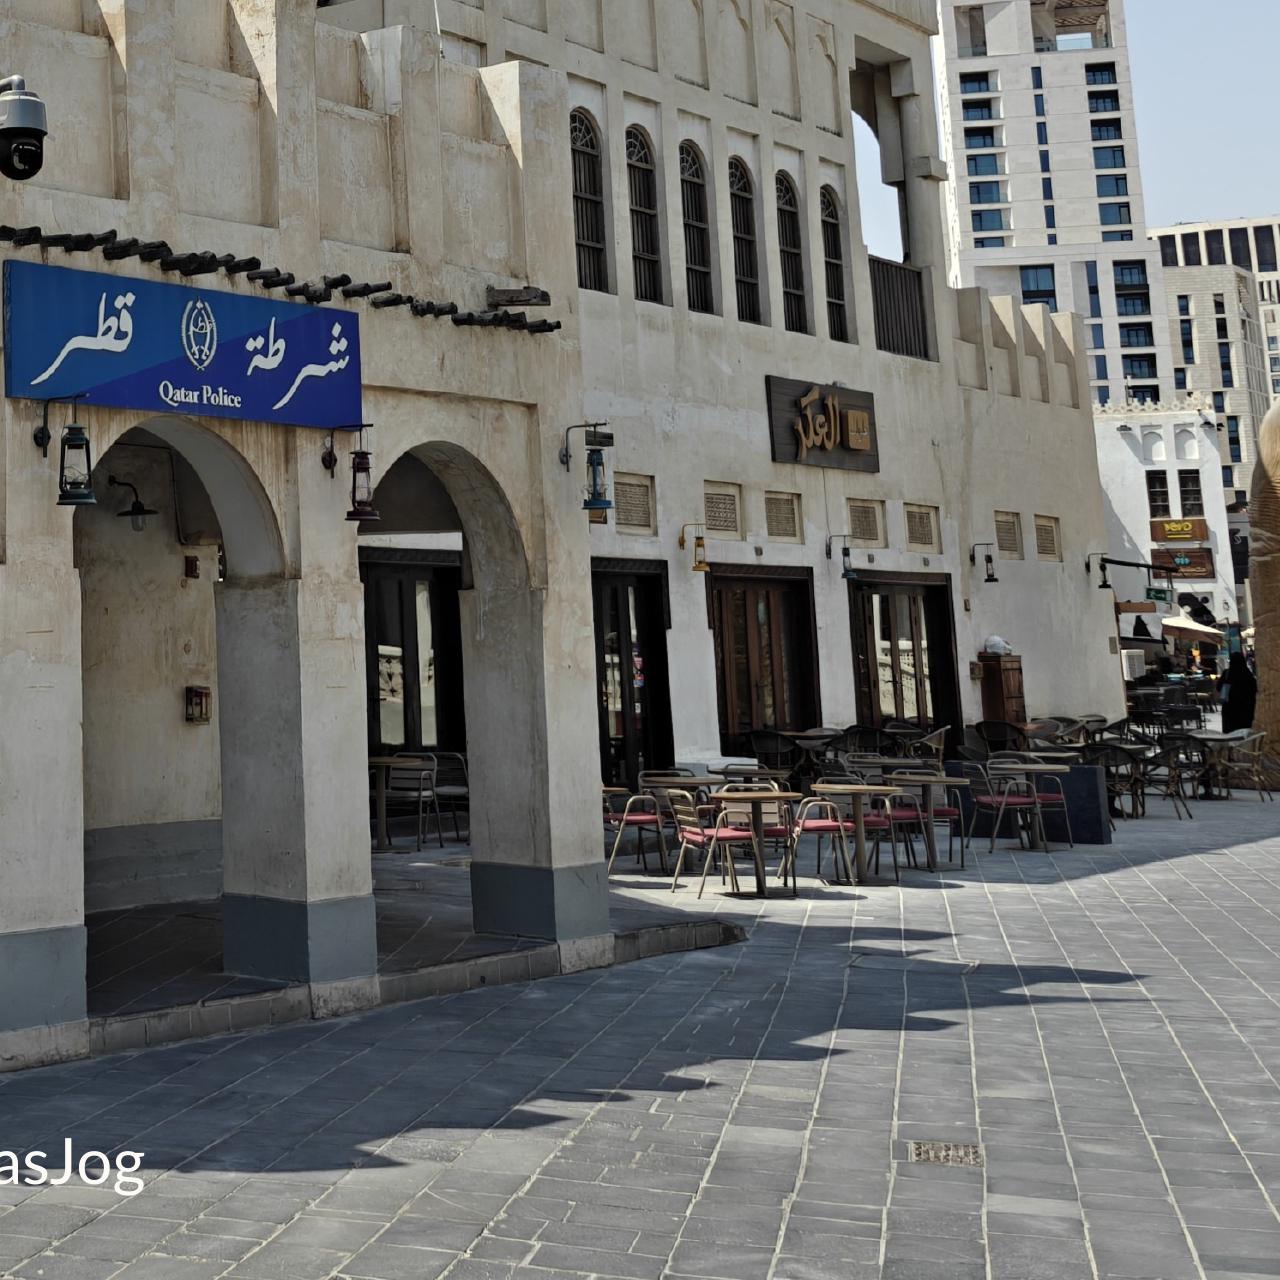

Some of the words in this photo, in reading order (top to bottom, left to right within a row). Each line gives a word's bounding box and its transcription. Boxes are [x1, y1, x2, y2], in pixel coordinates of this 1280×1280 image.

[30, 291, 137, 386] قطر
[245, 316, 350, 410] شرطة
[158, 380, 200, 407] Qatar
[201, 385, 242, 408] Police
